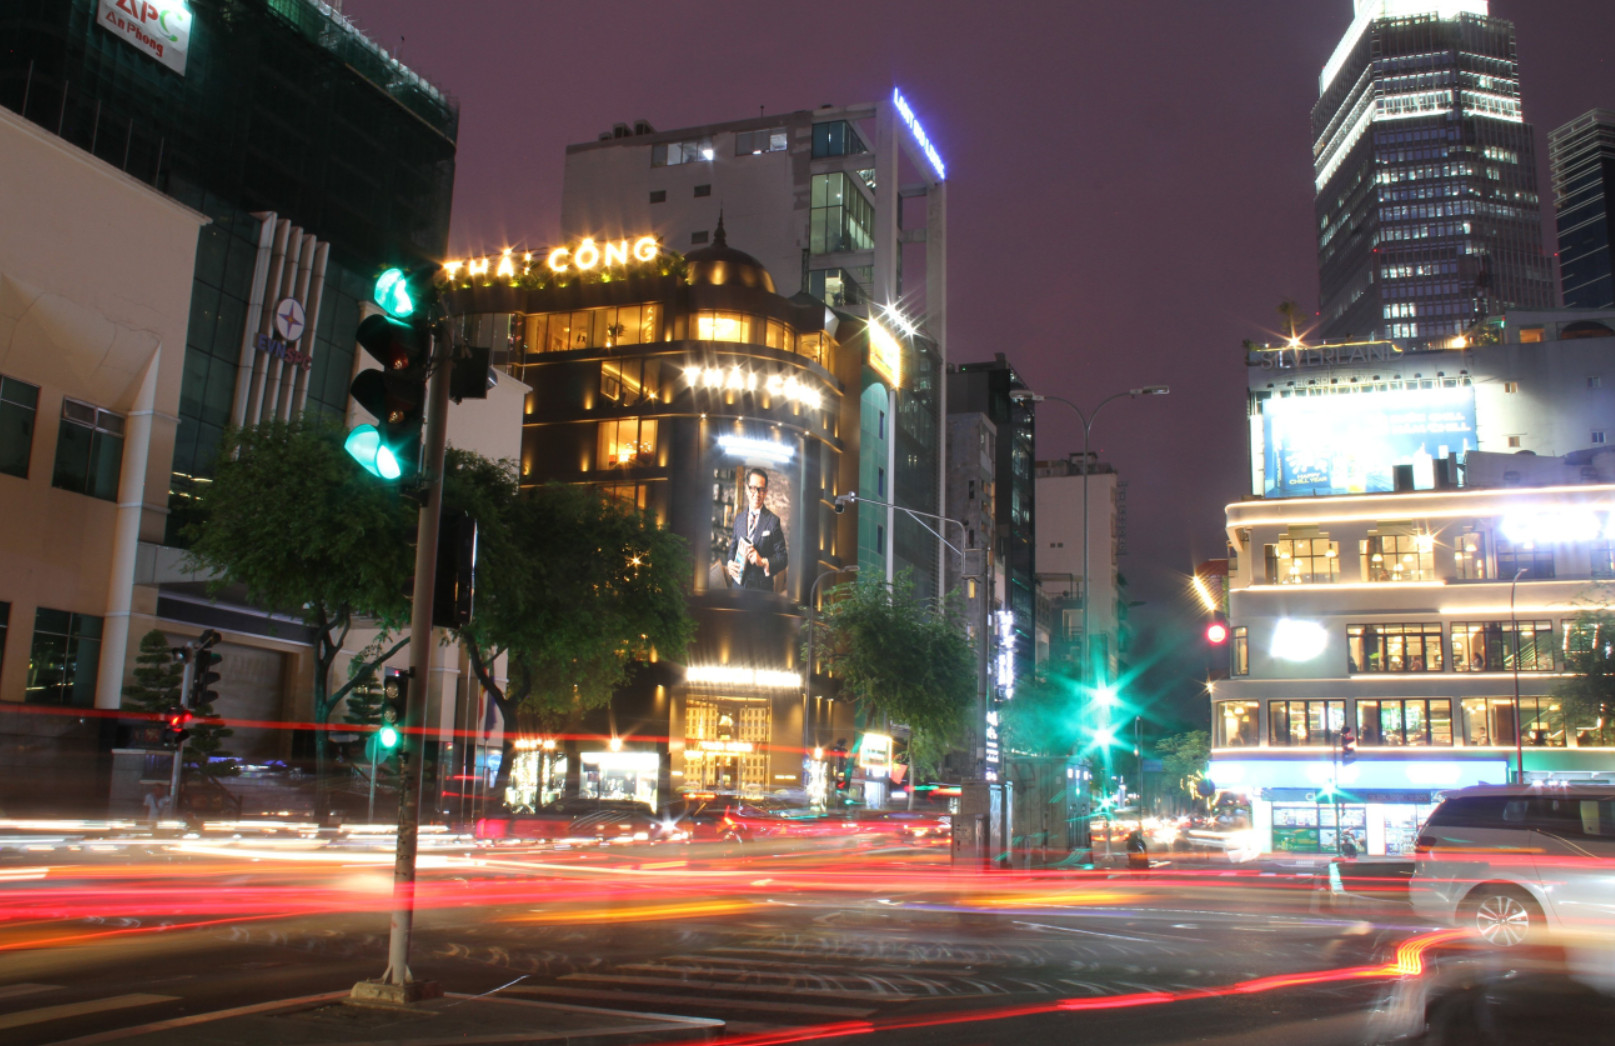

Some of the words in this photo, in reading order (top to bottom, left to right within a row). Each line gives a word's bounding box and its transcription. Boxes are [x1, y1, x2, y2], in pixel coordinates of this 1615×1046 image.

[105, 10, 125, 30] An
[127, 22, 164, 58] Phong
[548, 237, 659, 272] CÔNG
[1260, 343, 1404, 370] SILVERLAND
